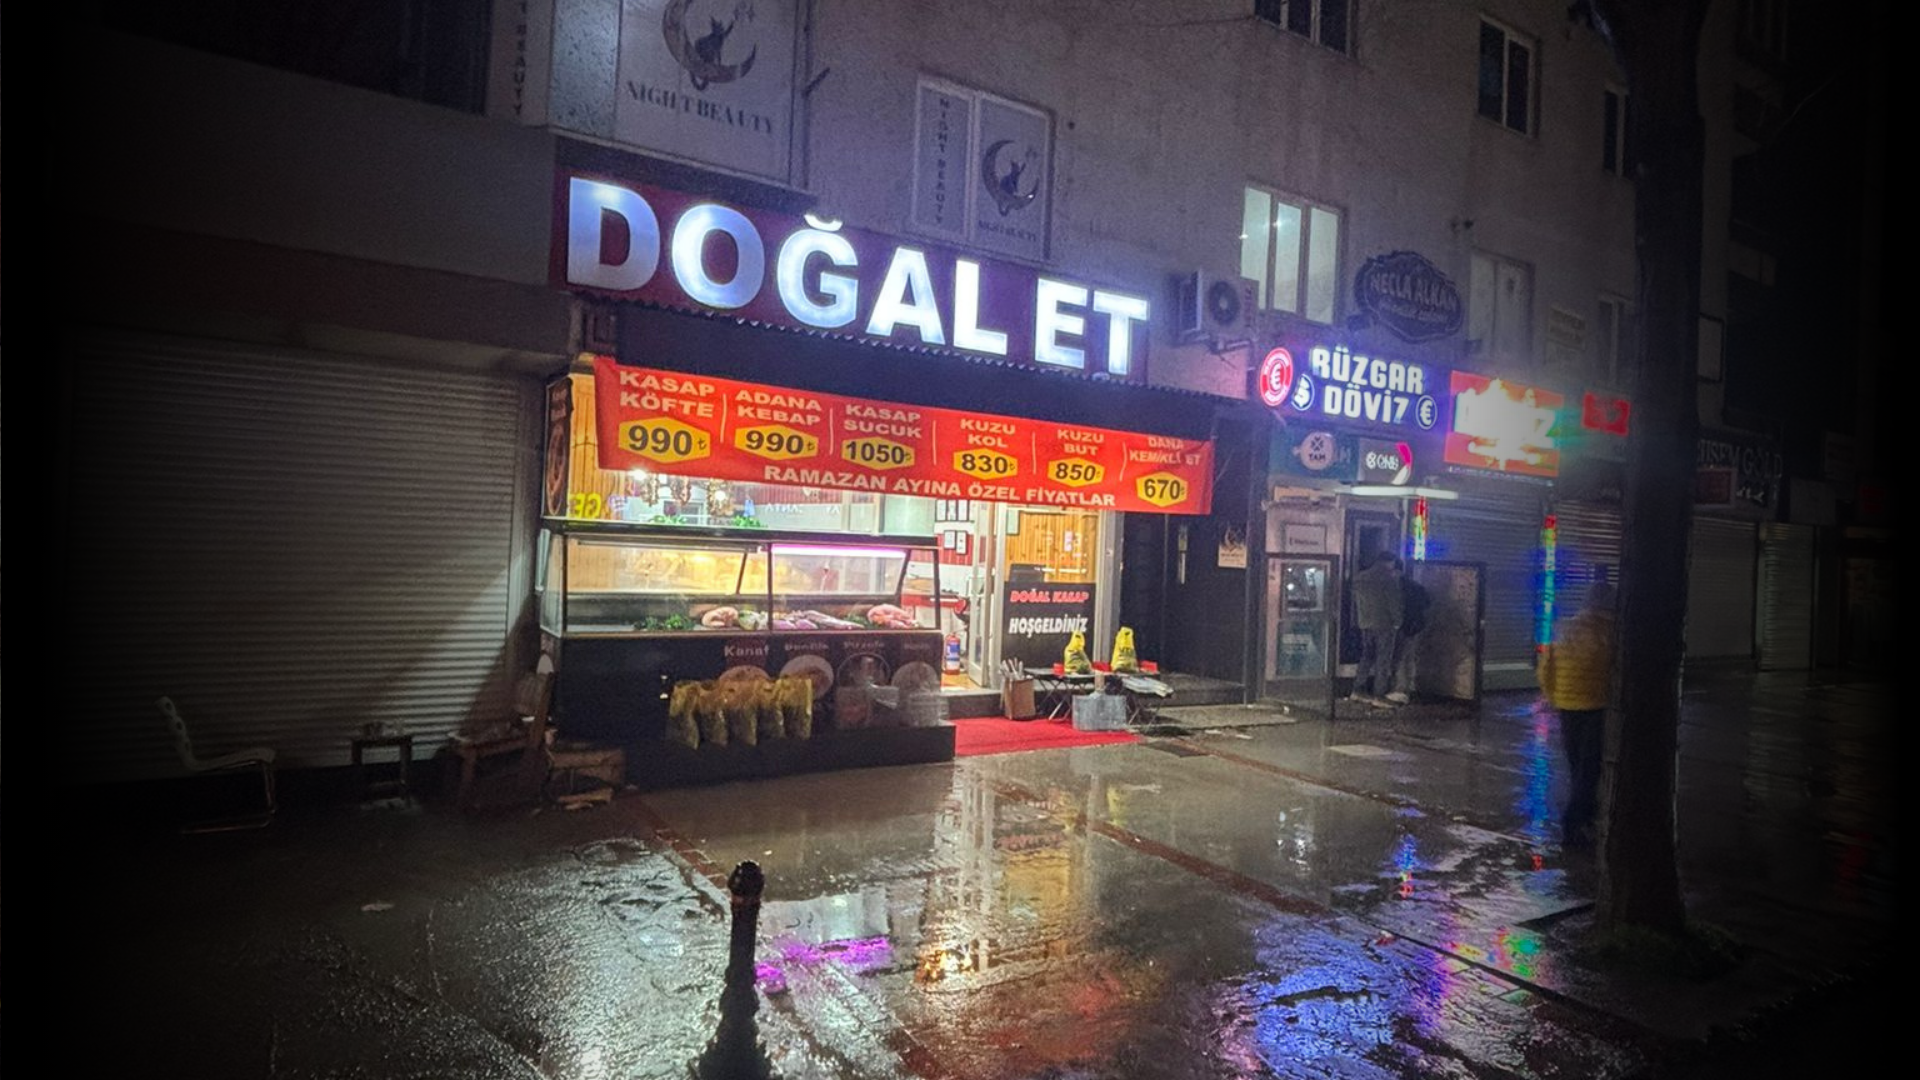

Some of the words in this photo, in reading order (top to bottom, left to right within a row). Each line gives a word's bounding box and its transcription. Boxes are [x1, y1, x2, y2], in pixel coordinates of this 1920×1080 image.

[566, 175, 1008, 356] DOĞAL
[1033, 277, 1149, 375] ET
[1310, 345, 1425, 396] RÜZGAR
[618, 370, 717, 397] KASAP
[618, 391, 714, 419] KÖFTE
[734, 389, 823, 413] ADANA
[736, 405, 822, 426] KEBAP
[845, 403, 921, 422] KASAP
[843, 419, 923, 439] SUCUK
[959, 418, 1016, 436] KUZU
[1056, 428, 1105, 444] KUZU
[967, 434, 1009, 448] KOL
[1063, 443, 1099, 456] BUT
[1147, 436, 1185, 450] DANA
[1129, 449, 1182, 465] KEMİKLİ
[1185, 454, 1202, 466] ET
[763, 465, 887, 491] RAMAZAN
[893, 478, 961, 497] AYINA
[967, 482, 1021, 501] ÖZEL
[1025, 486, 1116, 507] FİYATLAR
[1008, 614, 1088, 639] HOŞGELDİNİZ
